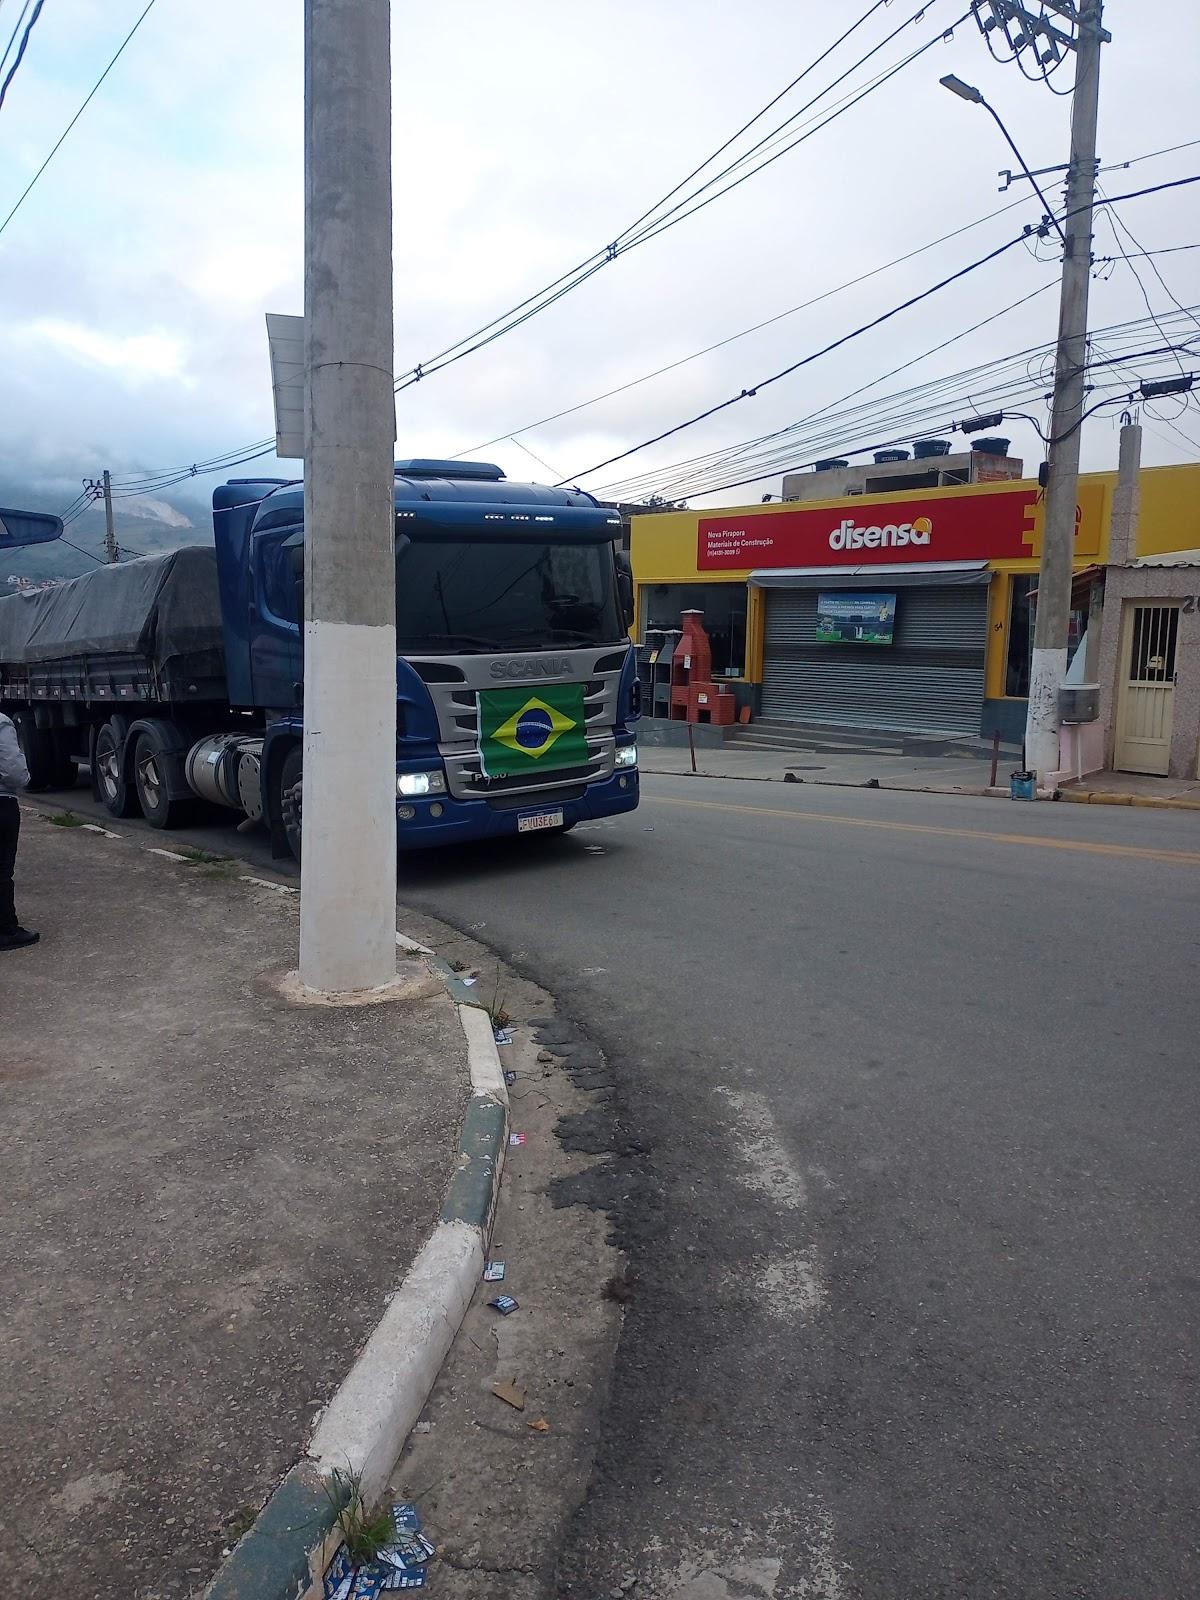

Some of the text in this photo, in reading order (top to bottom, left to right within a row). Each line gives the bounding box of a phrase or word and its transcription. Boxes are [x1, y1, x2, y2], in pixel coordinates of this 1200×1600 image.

[722, 530, 745, 538] Pirapora
[828, 517, 933, 550] disensa
[707, 540, 732, 548] Materiais
[741, 538, 774, 547] Construção
[490, 657, 575, 679] SCANIA
